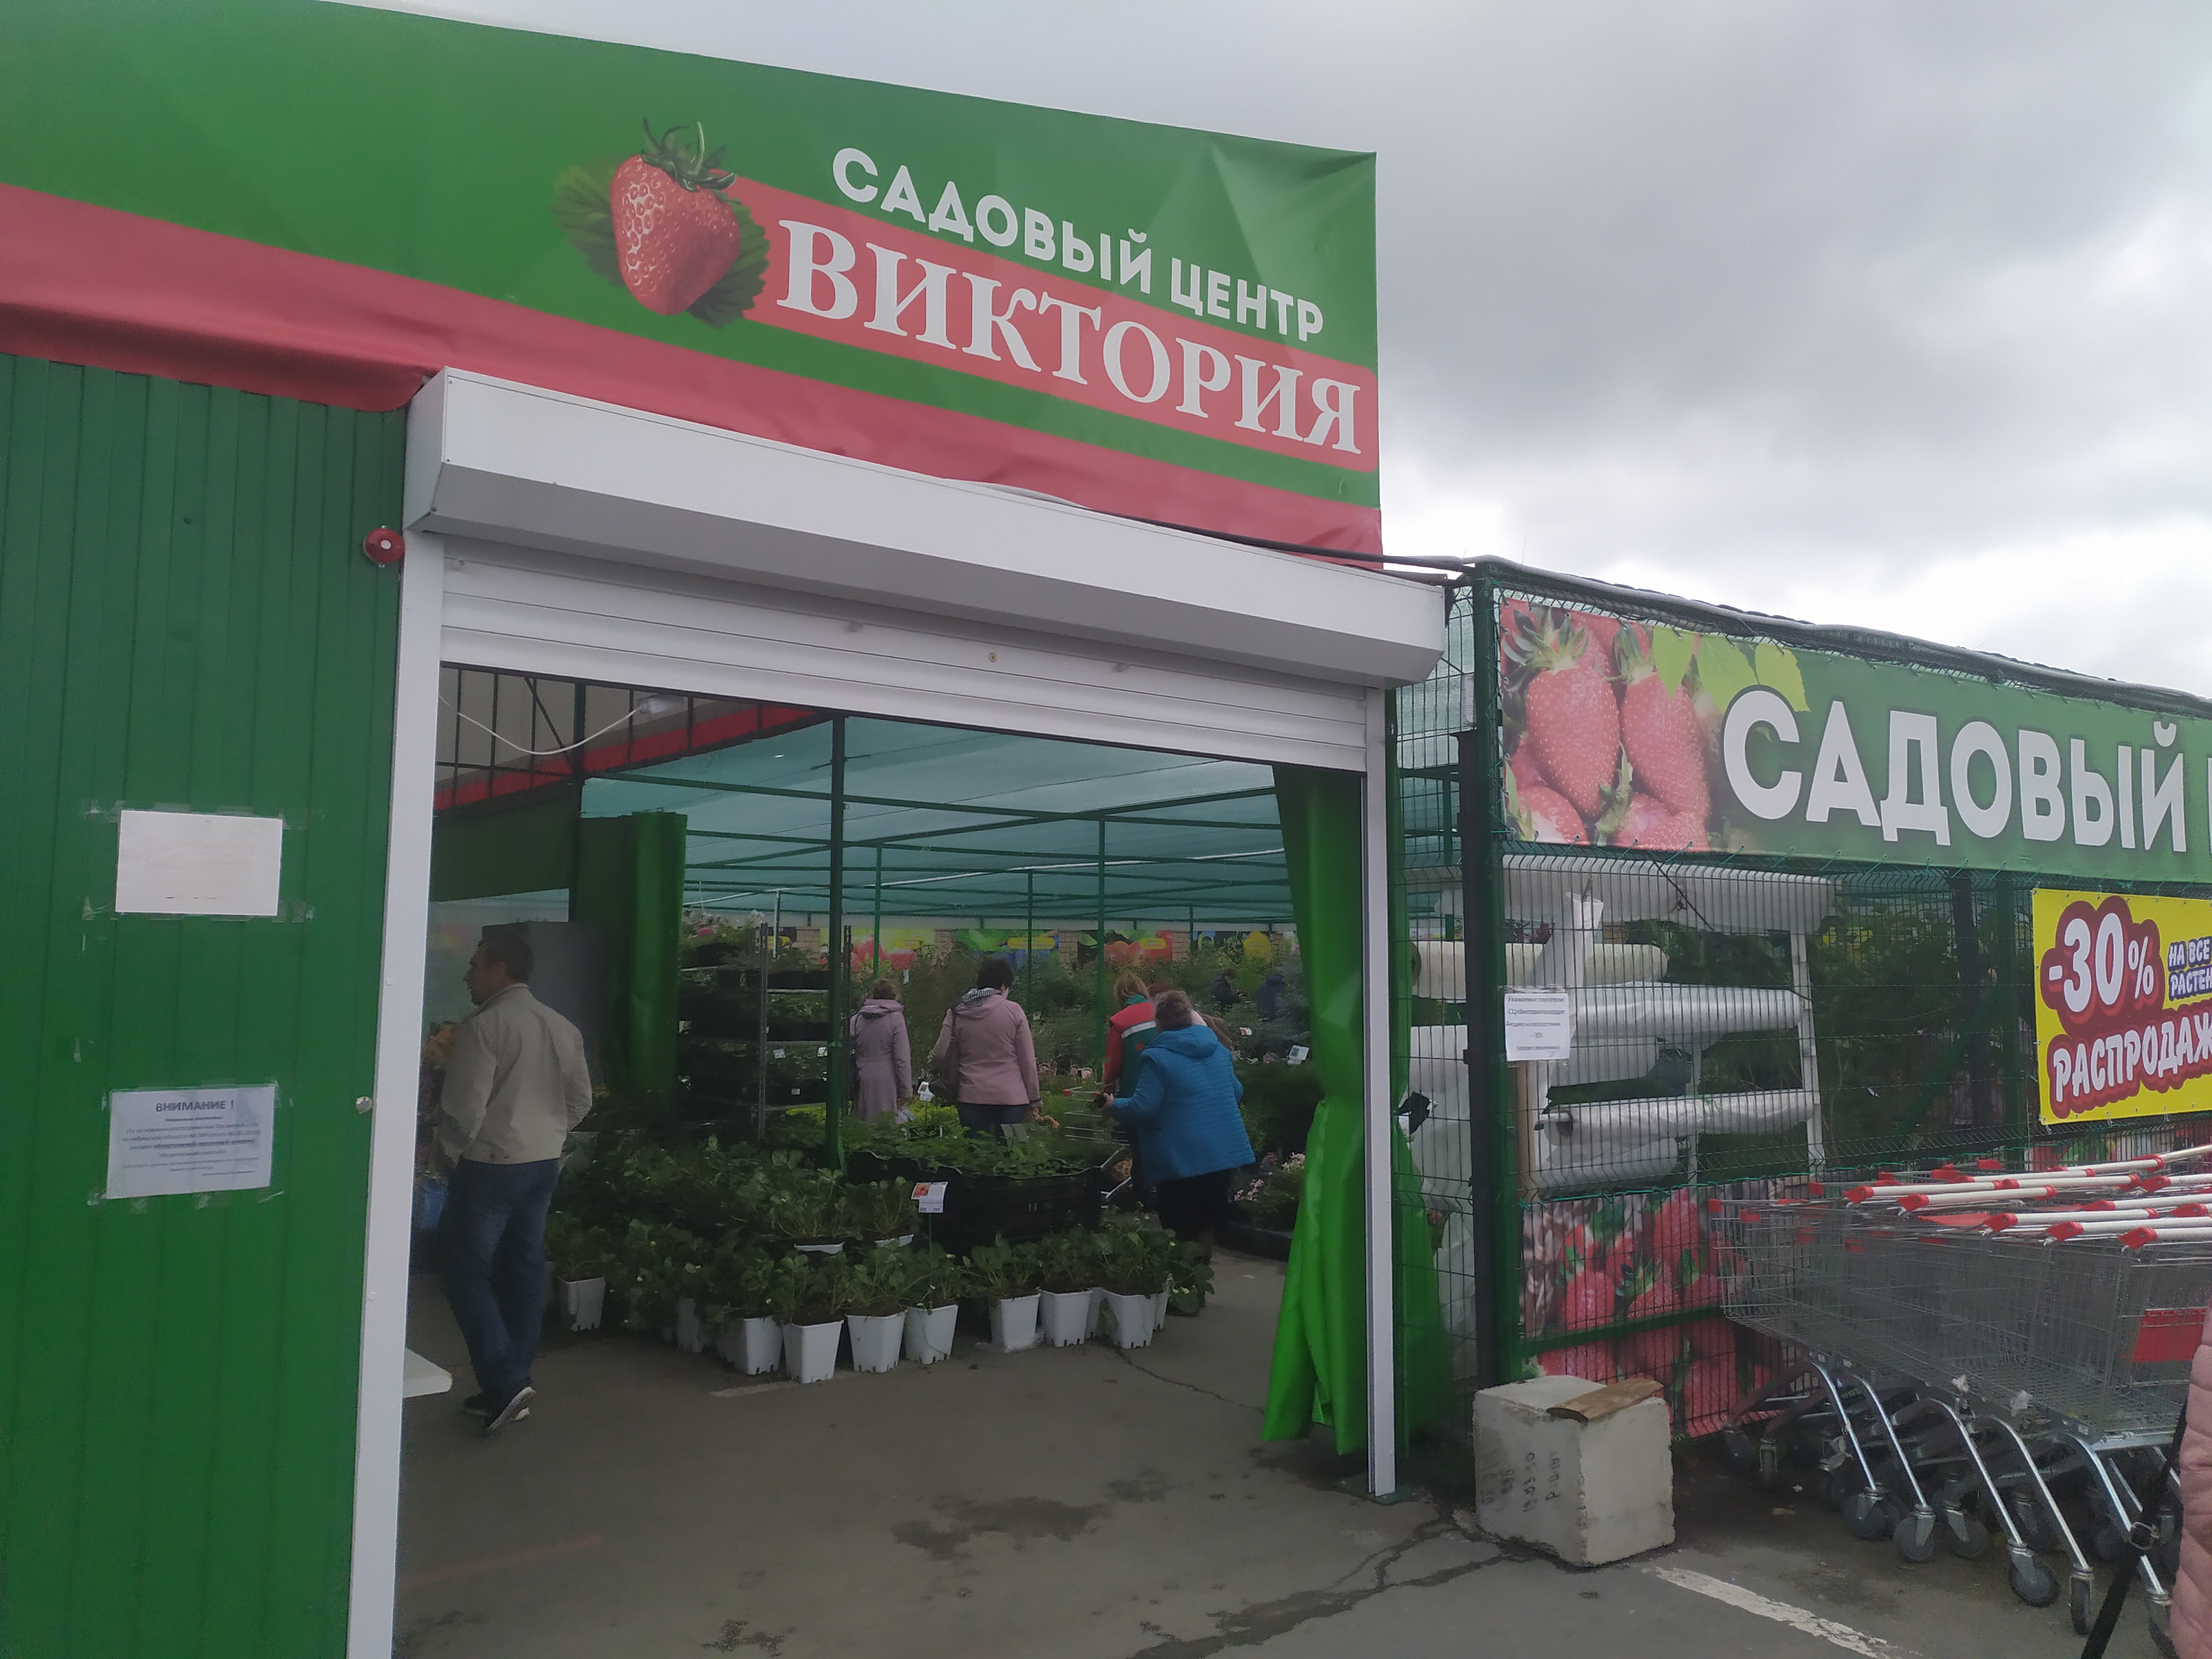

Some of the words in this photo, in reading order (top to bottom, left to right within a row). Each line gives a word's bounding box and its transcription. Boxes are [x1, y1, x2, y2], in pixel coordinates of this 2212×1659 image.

[832, 147, 1152, 294] САДОВЫЙ
[1170, 257, 1323, 342] ЦЕНТР
[776, 219, 1361, 454] ВИКТОРИЯ
[1723, 690, 2187, 852] САДОВЫЙ
[2049, 912, 2154, 1012] -30%
[2169, 943, 2185, 967] НА
[2189, 939, 2210, 963] ВСЕ
[155, 1100, 226, 1112] ВНИМАНИЕ
